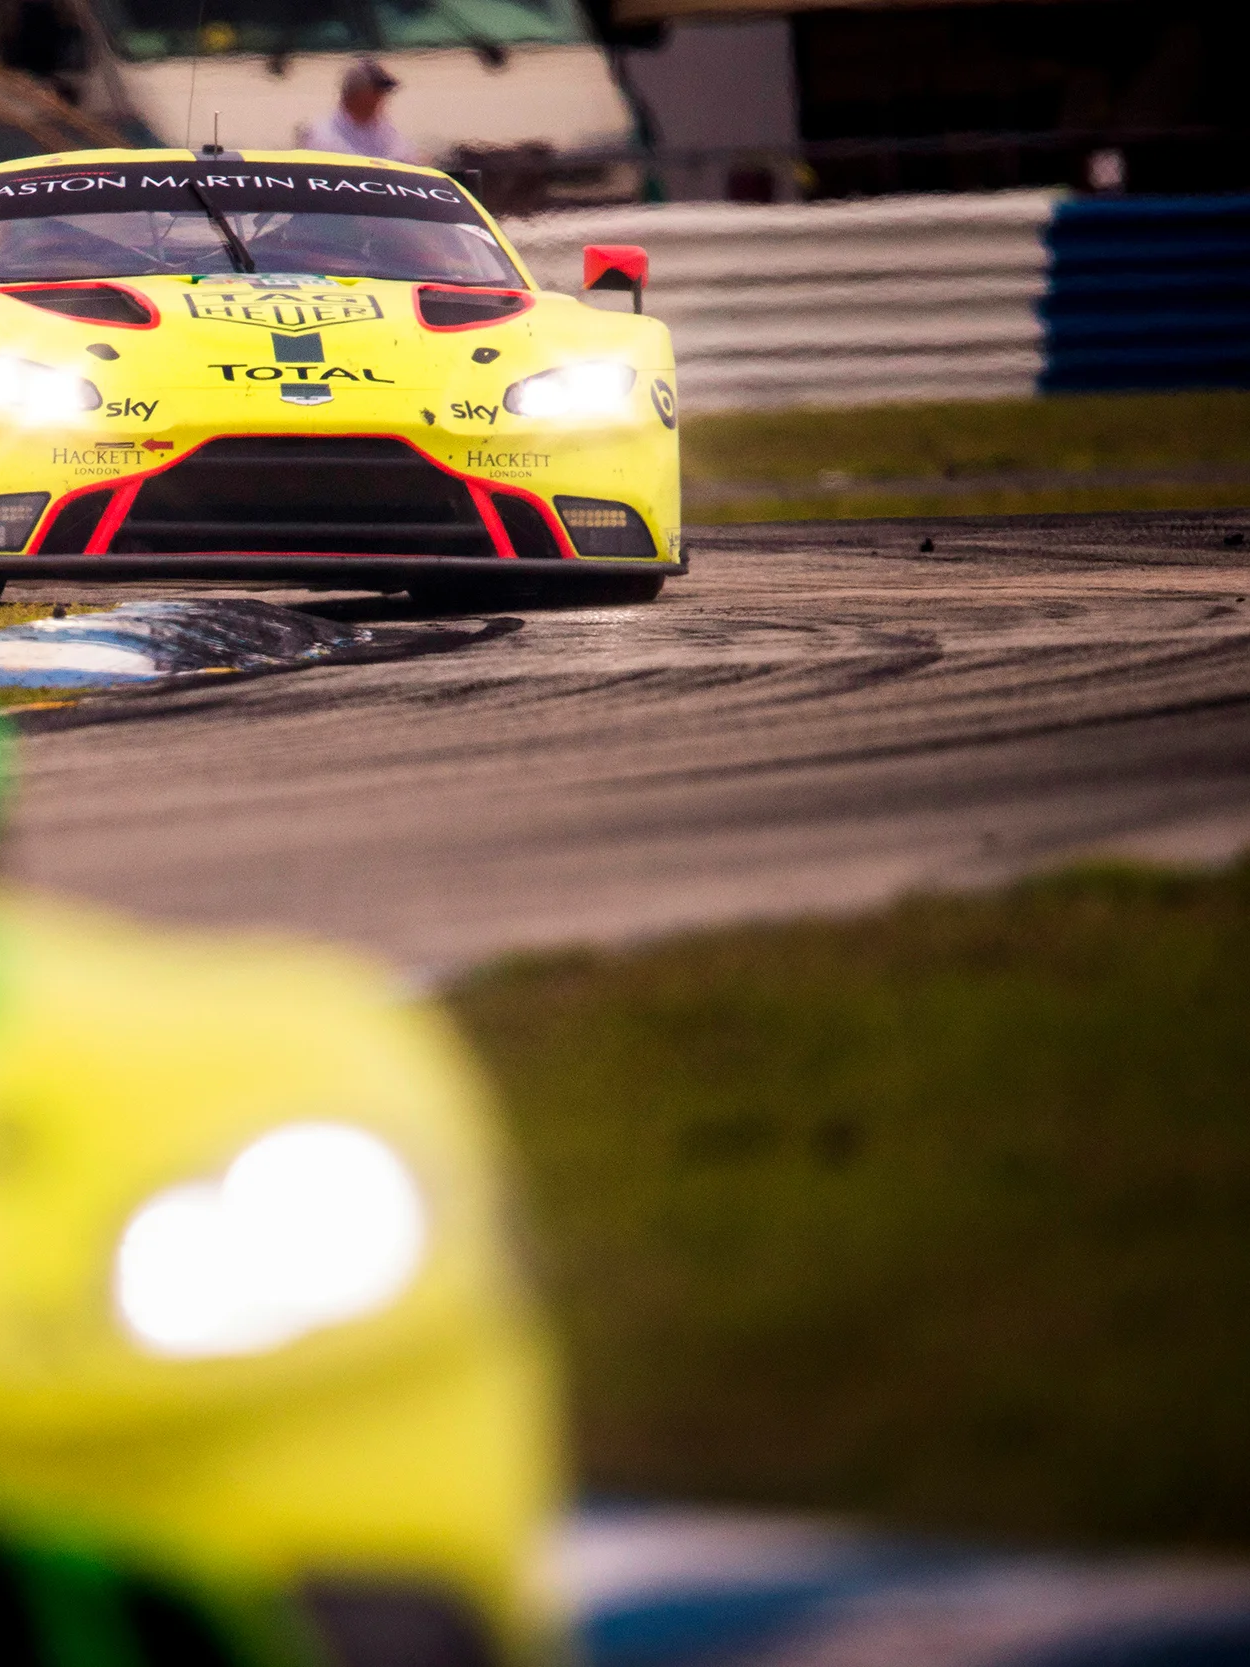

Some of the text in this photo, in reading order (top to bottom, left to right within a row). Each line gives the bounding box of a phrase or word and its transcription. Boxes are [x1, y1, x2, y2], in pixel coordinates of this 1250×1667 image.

[140, 175, 295, 189] MARTIN
[308, 178, 461, 203] RACING
[201, 293, 358, 302] TAG
[205, 305, 368, 326] HEUER
[207, 364, 395, 384] TOTAL
[106, 398, 159, 422] sky
[450, 400, 499, 424] sky
[52, 448, 145, 465] HACKETT
[467, 451, 550, 468] HACKETT
[74, 467, 120, 475] LONDON
[489, 470, 532, 478] LONDON
